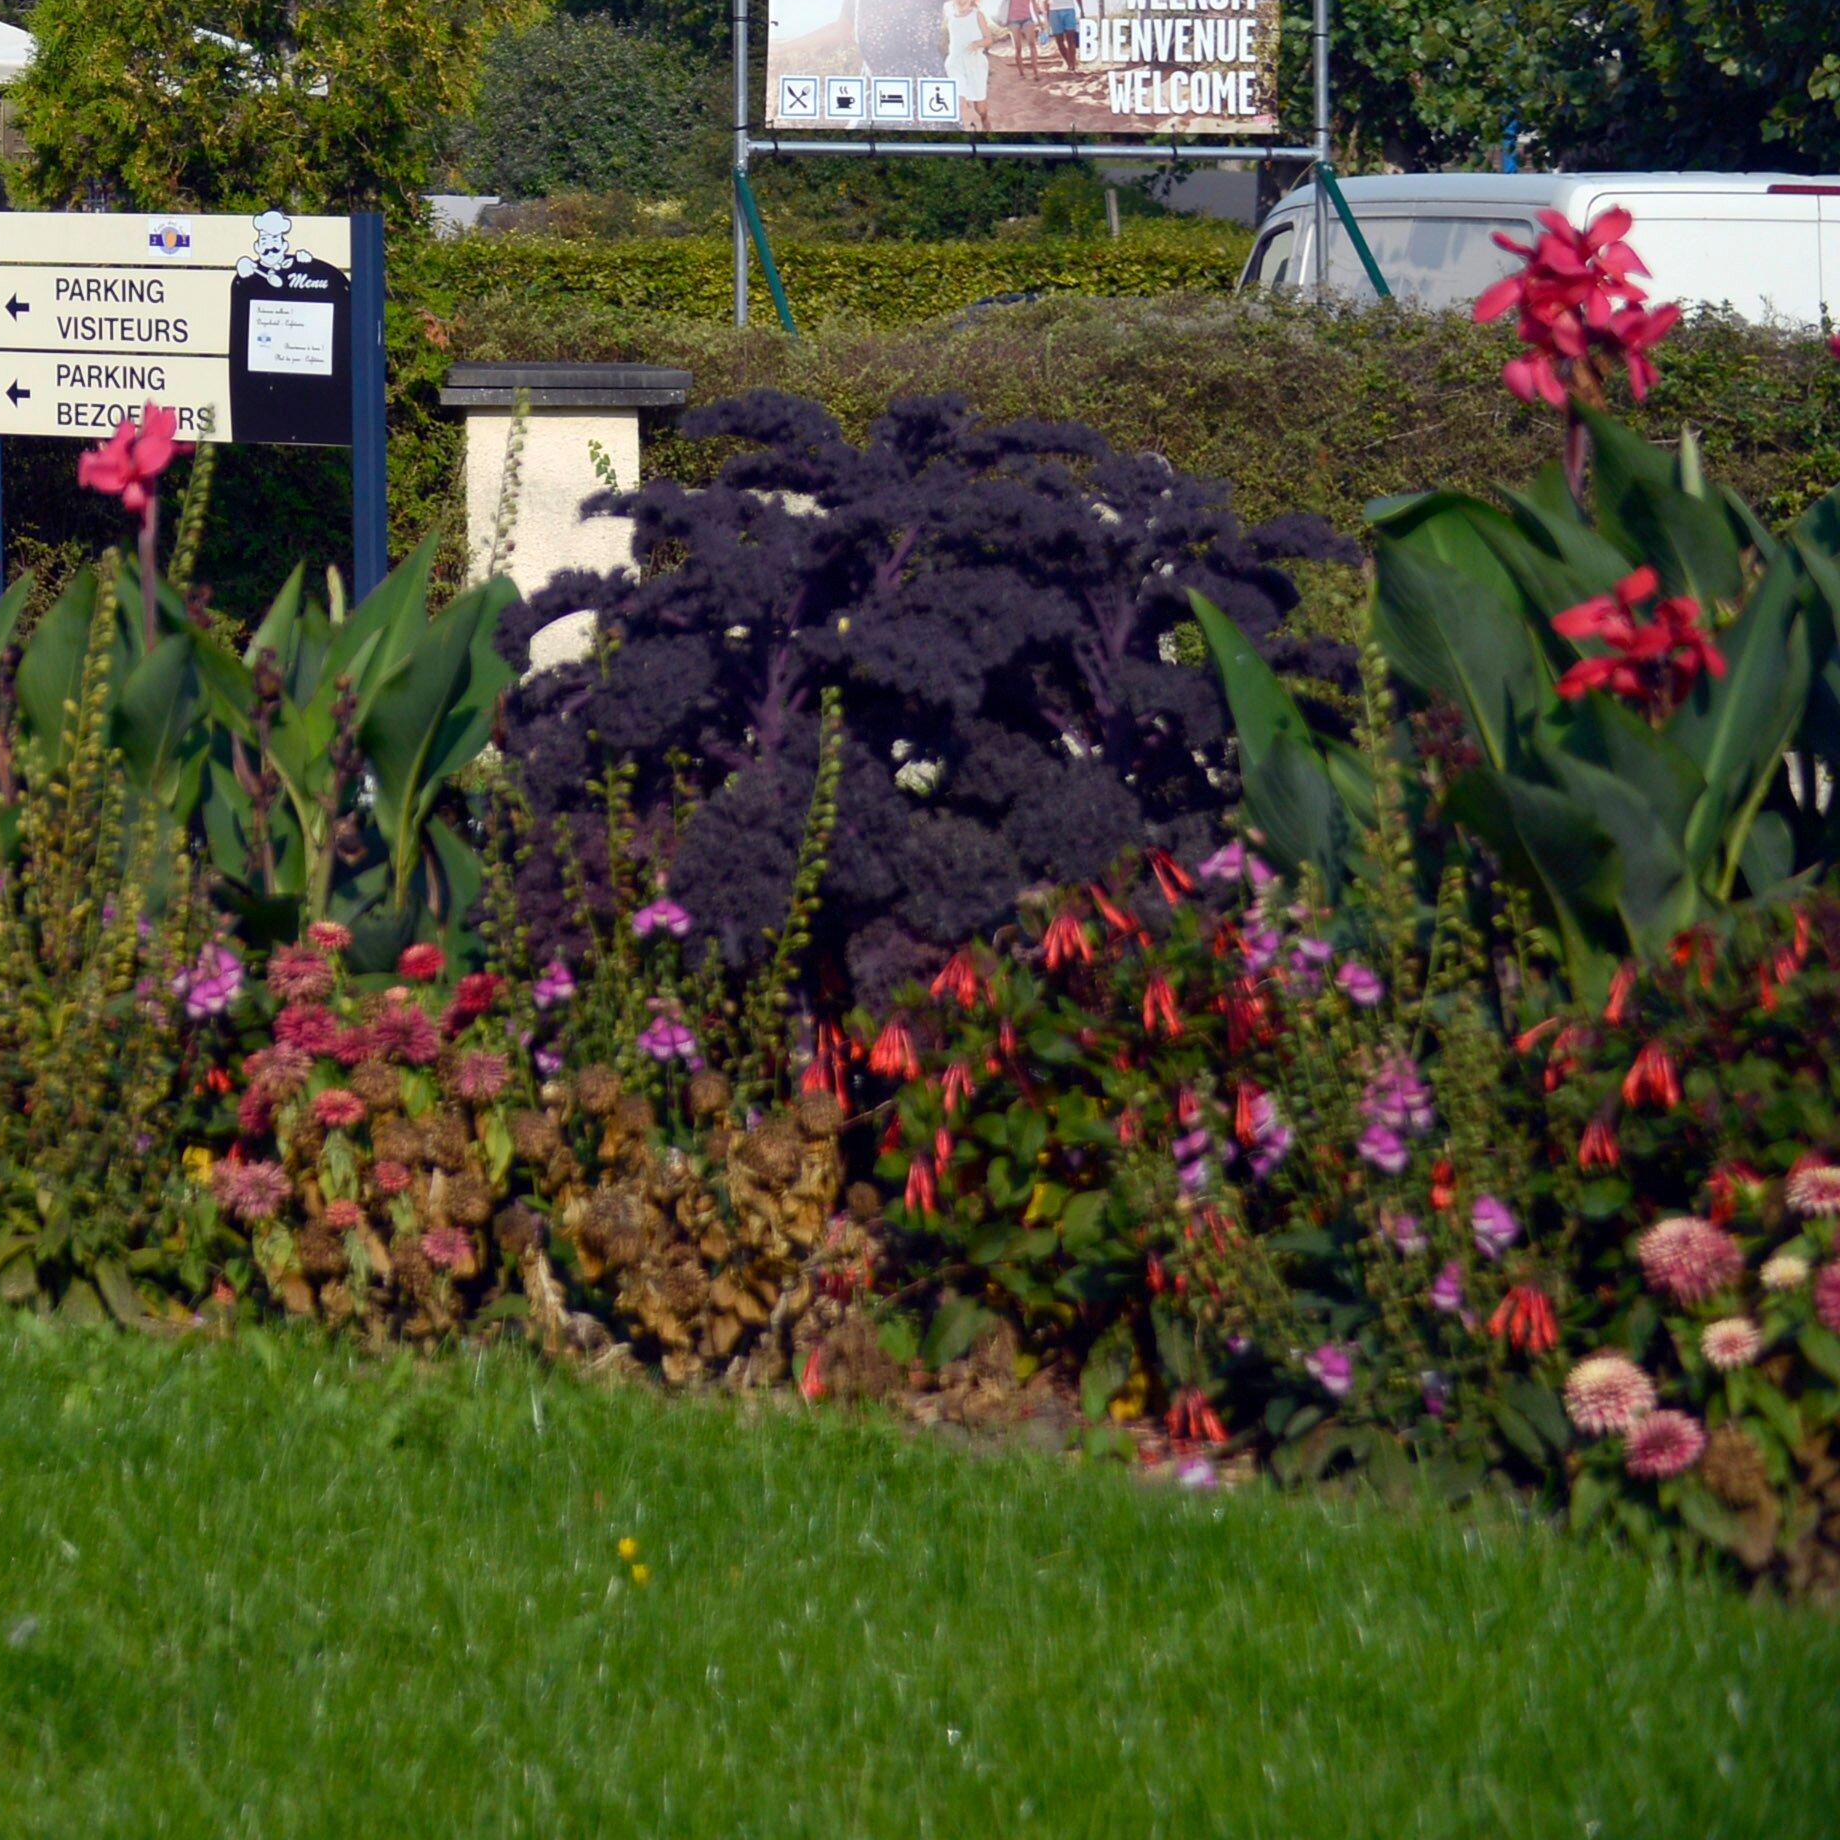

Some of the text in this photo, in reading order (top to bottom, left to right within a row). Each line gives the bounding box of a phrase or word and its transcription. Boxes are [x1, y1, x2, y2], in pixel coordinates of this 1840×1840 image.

[1079, 18, 1257, 63] BIENVENUE
[1108, 71, 1256, 115] WELCOME
[56, 278, 164, 303] PARKING
[287, 272, 328, 289] Menu
[56, 316, 188, 343] VISITEURS
[56, 364, 165, 390] PARKING
[57, 402, 214, 433] BEZOERS
